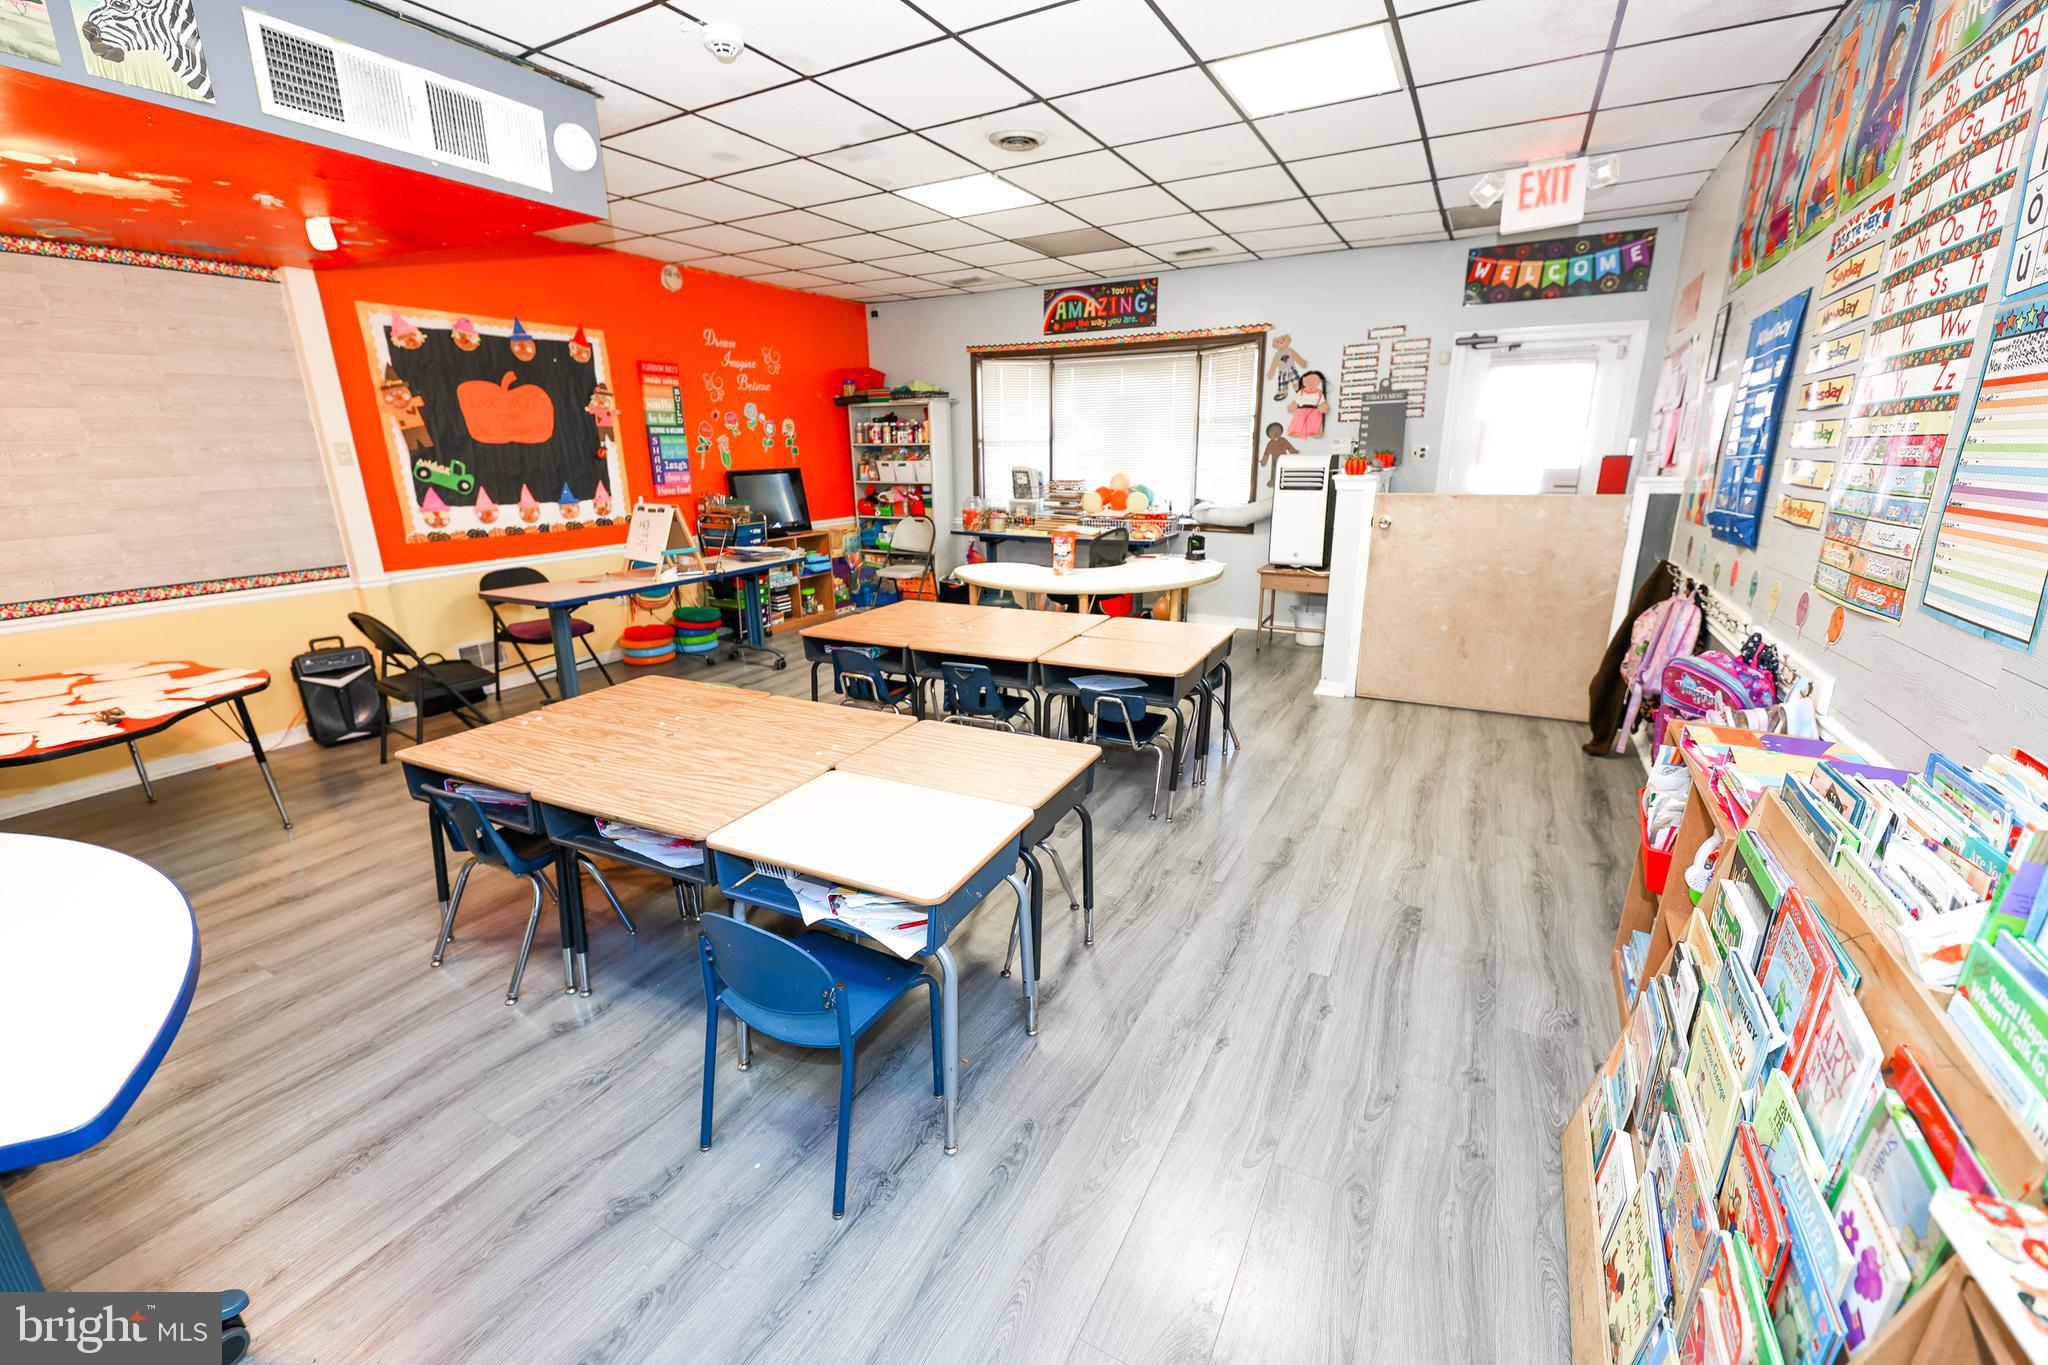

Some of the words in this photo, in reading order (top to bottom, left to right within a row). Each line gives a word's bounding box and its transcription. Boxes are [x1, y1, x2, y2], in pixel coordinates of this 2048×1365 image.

[1918, 106, 1934, 135] Aa
[1943, 79, 1960, 114] Bb
[1974, 55, 1995, 89] Cc
[2011, 14, 2044, 66] Dd
[1909, 154, 1922, 182] Ee
[1933, 128, 1948, 165] Ff
[1959, 112, 1984, 144] Gg
[2000, 78, 2027, 122] Hh
[1517, 163, 1576, 211] EXIT
[1948, 160, 1971, 197] Kk
[1890, 247, 1908, 272] Mm
[1940, 215, 1964, 246] Oo
[1977, 199, 1997, 237] Pp
[1474, 245, 1642, 280] WELCOME
[1904, 278, 1917, 306] Rr
[1930, 267, 1948, 296] Ss
[1969, 252, 1984, 285] Tt
[1055, 293, 1148, 320] AMAZING
[1061, 320, 1076, 332] just
[1078, 319, 1089, 327] the
[1090, 319, 1106, 328] way
[1107, 317, 1122, 326] you
[703, 328, 737, 349] Dream
[1901, 322, 1915, 348] Vv
[1940, 307, 1972, 340] Ww
[720, 350, 757, 372] Imagine
[1933, 360, 1957, 392] Zz
[736, 373, 772, 392] Believe
[1365, 393, 1387, 401] TODAY'S
[1388, 392, 1405, 400] MENU
[673, 388, 684, 425] BUILD
[651, 437, 663, 483] SHARE
[664, 460, 688, 473] laugh
[657, 486, 676, 497] Have
[1674, 679, 1716, 704] Vampirin
[1989, 975, 2022, 1020] What
[1970, 980, 2002, 1025] When
[2007, 1022, 2034, 1065] Talk
[2031, 1054, 2046, 1078] to
